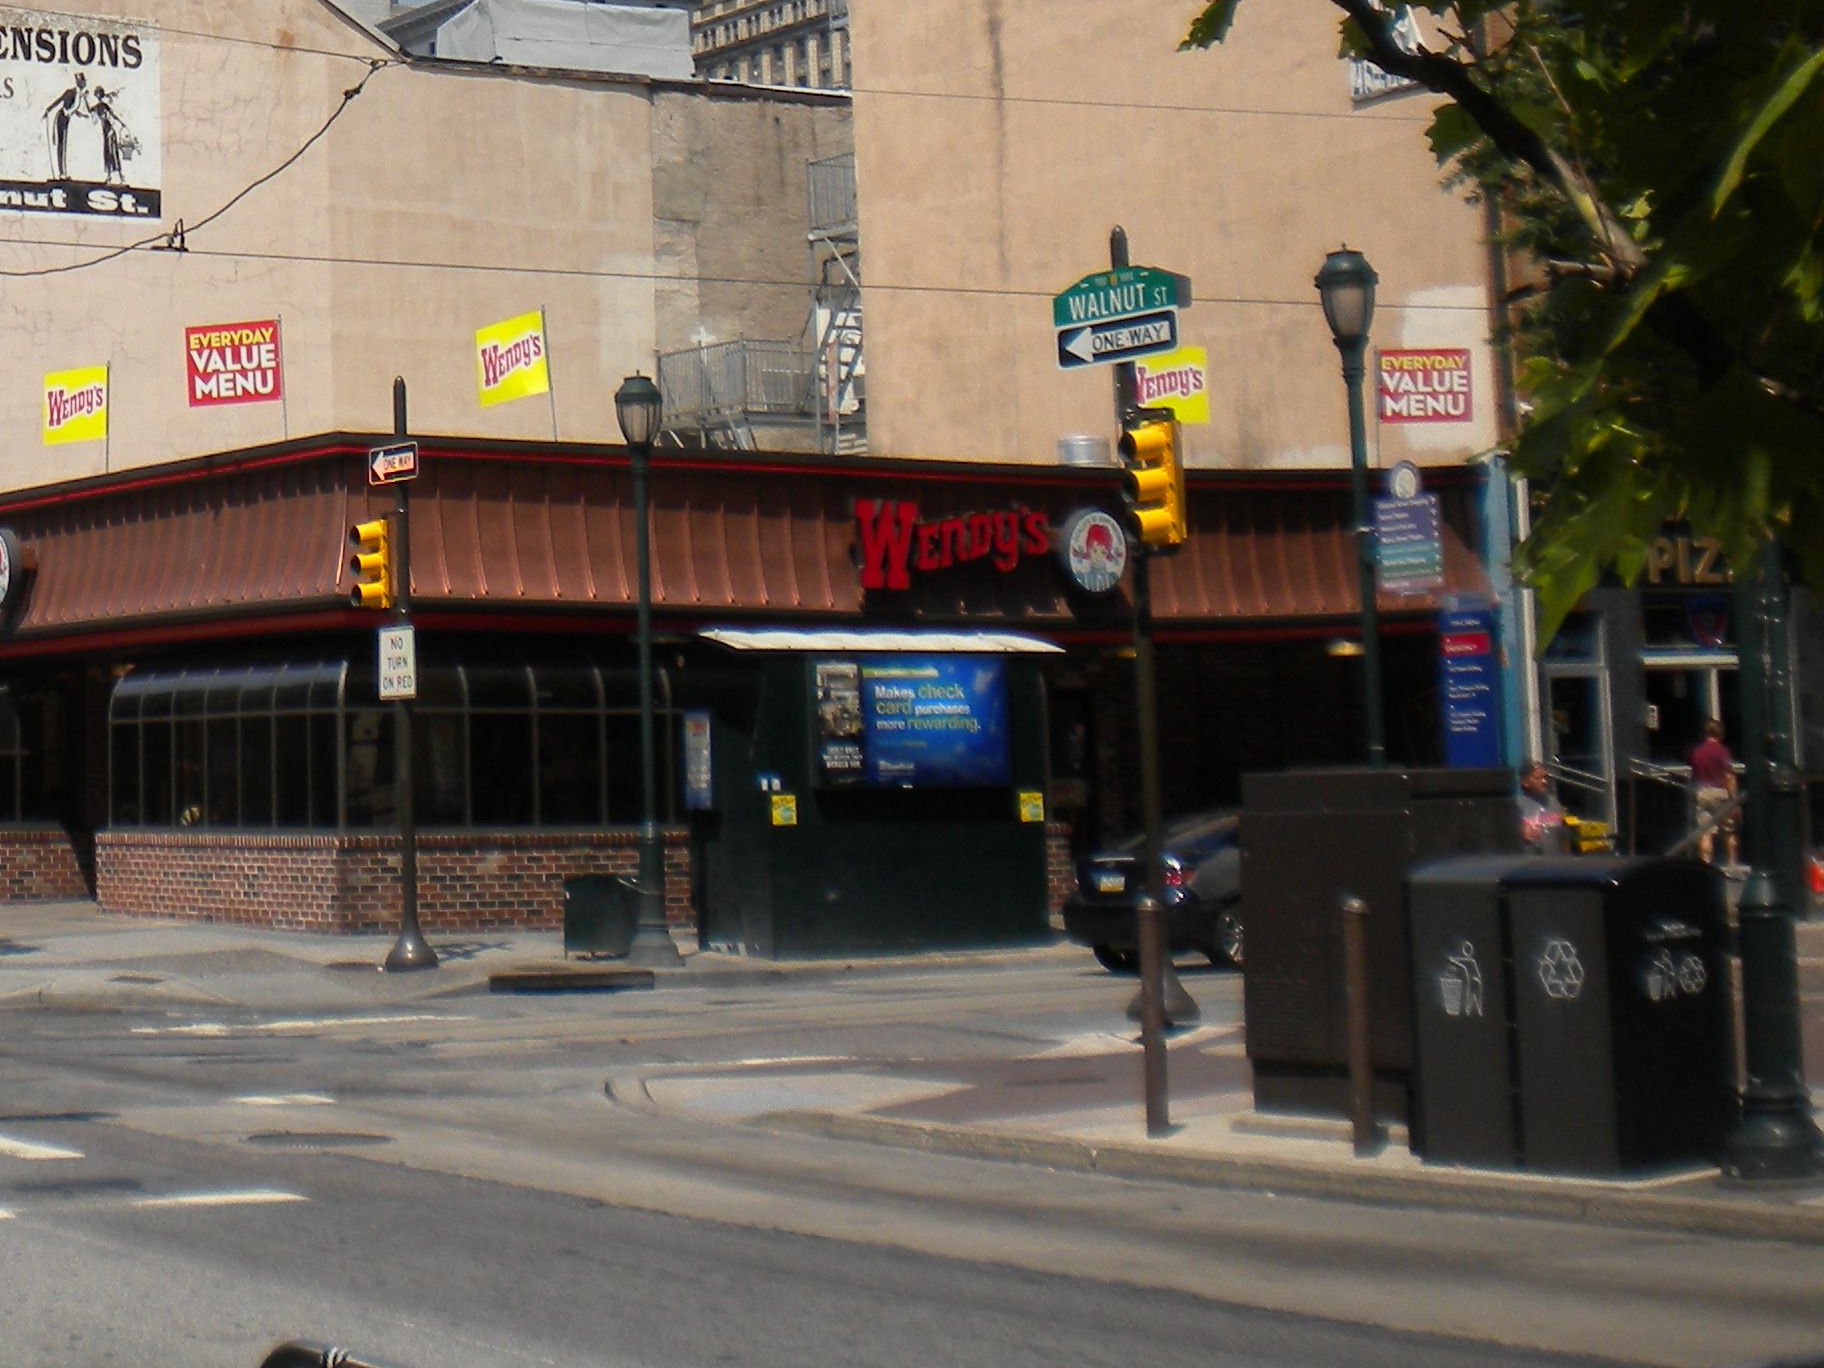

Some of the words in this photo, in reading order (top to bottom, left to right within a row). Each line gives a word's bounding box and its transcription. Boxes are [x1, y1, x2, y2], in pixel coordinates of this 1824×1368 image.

[87, 189, 150, 214] St.
[1069, 283, 1146, 321] WALNUT
[1153, 287, 1168, 305] ST
[189, 327, 274, 349] EVERYDAY
[1092, 332, 1125, 352] ONE
[1126, 324, 1164, 345] WAY
[190, 343, 276, 374] VALUE
[1381, 355, 1467, 370] EVERYDAY
[194, 369, 274, 400] MENU
[1381, 371, 1468, 393] VALUE
[1385, 394, 1465, 417] MENU
[384, 457, 396, 471] ONE
[398, 454, 411, 468] WAY
[1649, 537, 1733, 584] PIZ
[390, 637, 403, 650] NO
[387, 656, 408, 670] TURN
[383, 676, 394, 690] ON
[397, 675, 413, 689] RED
[875, 685, 915, 699] Makes
[918, 684, 965, 699] check
[876, 700, 911, 715] card
[876, 719, 905, 730] more
